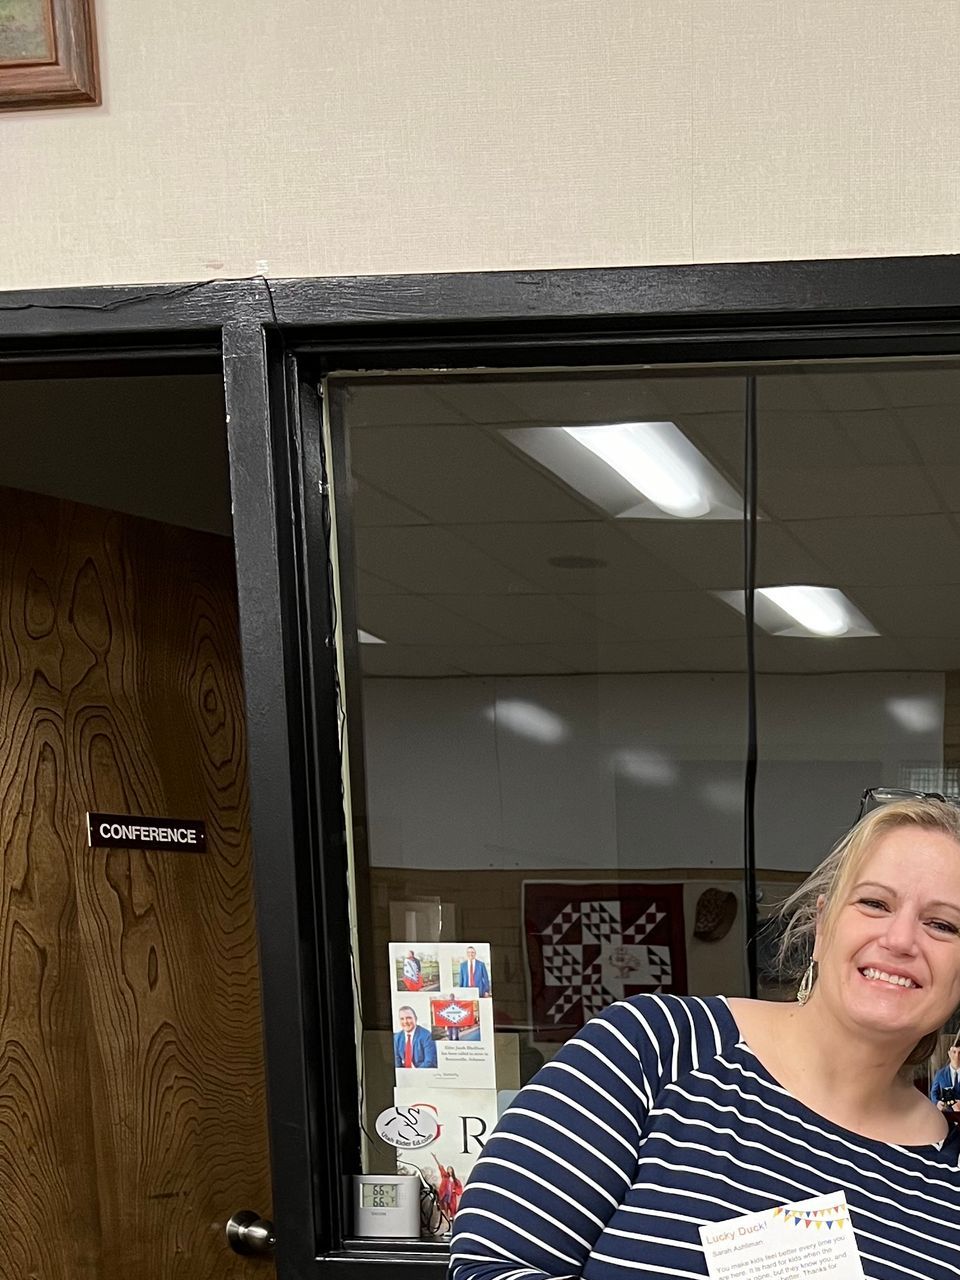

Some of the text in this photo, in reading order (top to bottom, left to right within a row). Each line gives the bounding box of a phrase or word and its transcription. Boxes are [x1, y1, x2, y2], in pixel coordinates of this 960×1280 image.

[99, 822, 197, 844] CONFERENCE
[706, 1221, 768, 1244] Lucky Duck!
[731, 1261, 749, 1269] make
[779, 1248, 797, 1257] better
[762, 1262, 777, 1270] hard
[800, 1261, 817, 1269] know
[803, 1266, 827, 1276] Thanks
